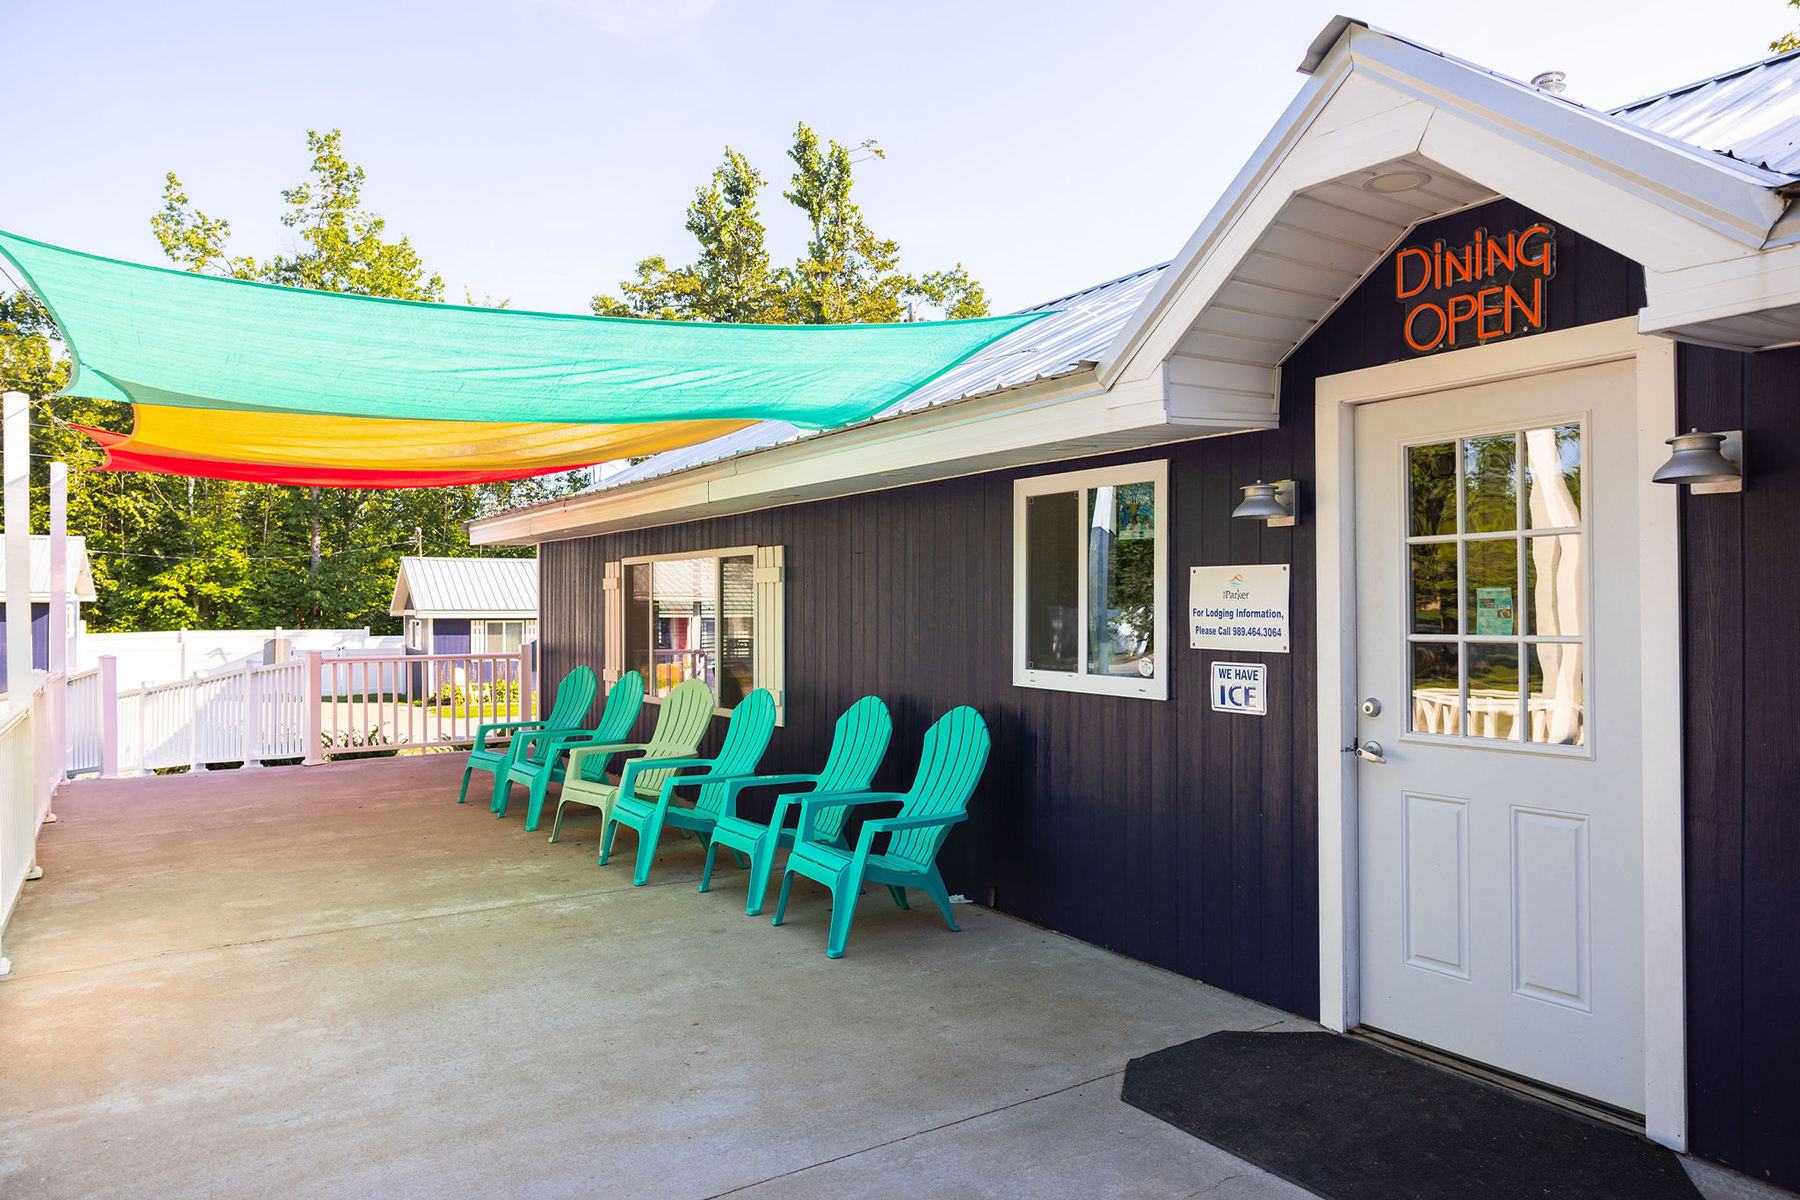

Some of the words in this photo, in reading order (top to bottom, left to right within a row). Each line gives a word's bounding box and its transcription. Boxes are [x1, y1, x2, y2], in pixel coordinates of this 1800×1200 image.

[1405, 278, 1541, 351] OPEN
[1225, 588, 1249, 600] Parker
[1192, 608, 1204, 617] For
[1205, 608, 1234, 620] Lodging
[1236, 608, 1284, 621] Information,
[1195, 626, 1217, 635] Please
[1218, 626, 1231, 636] Call
[1232, 626, 1282, 637] 989.464.3064
[1218, 668, 1232, 679] WE
[1234, 669, 1259, 681] HAVE
[1219, 683, 1257, 708] ICE
